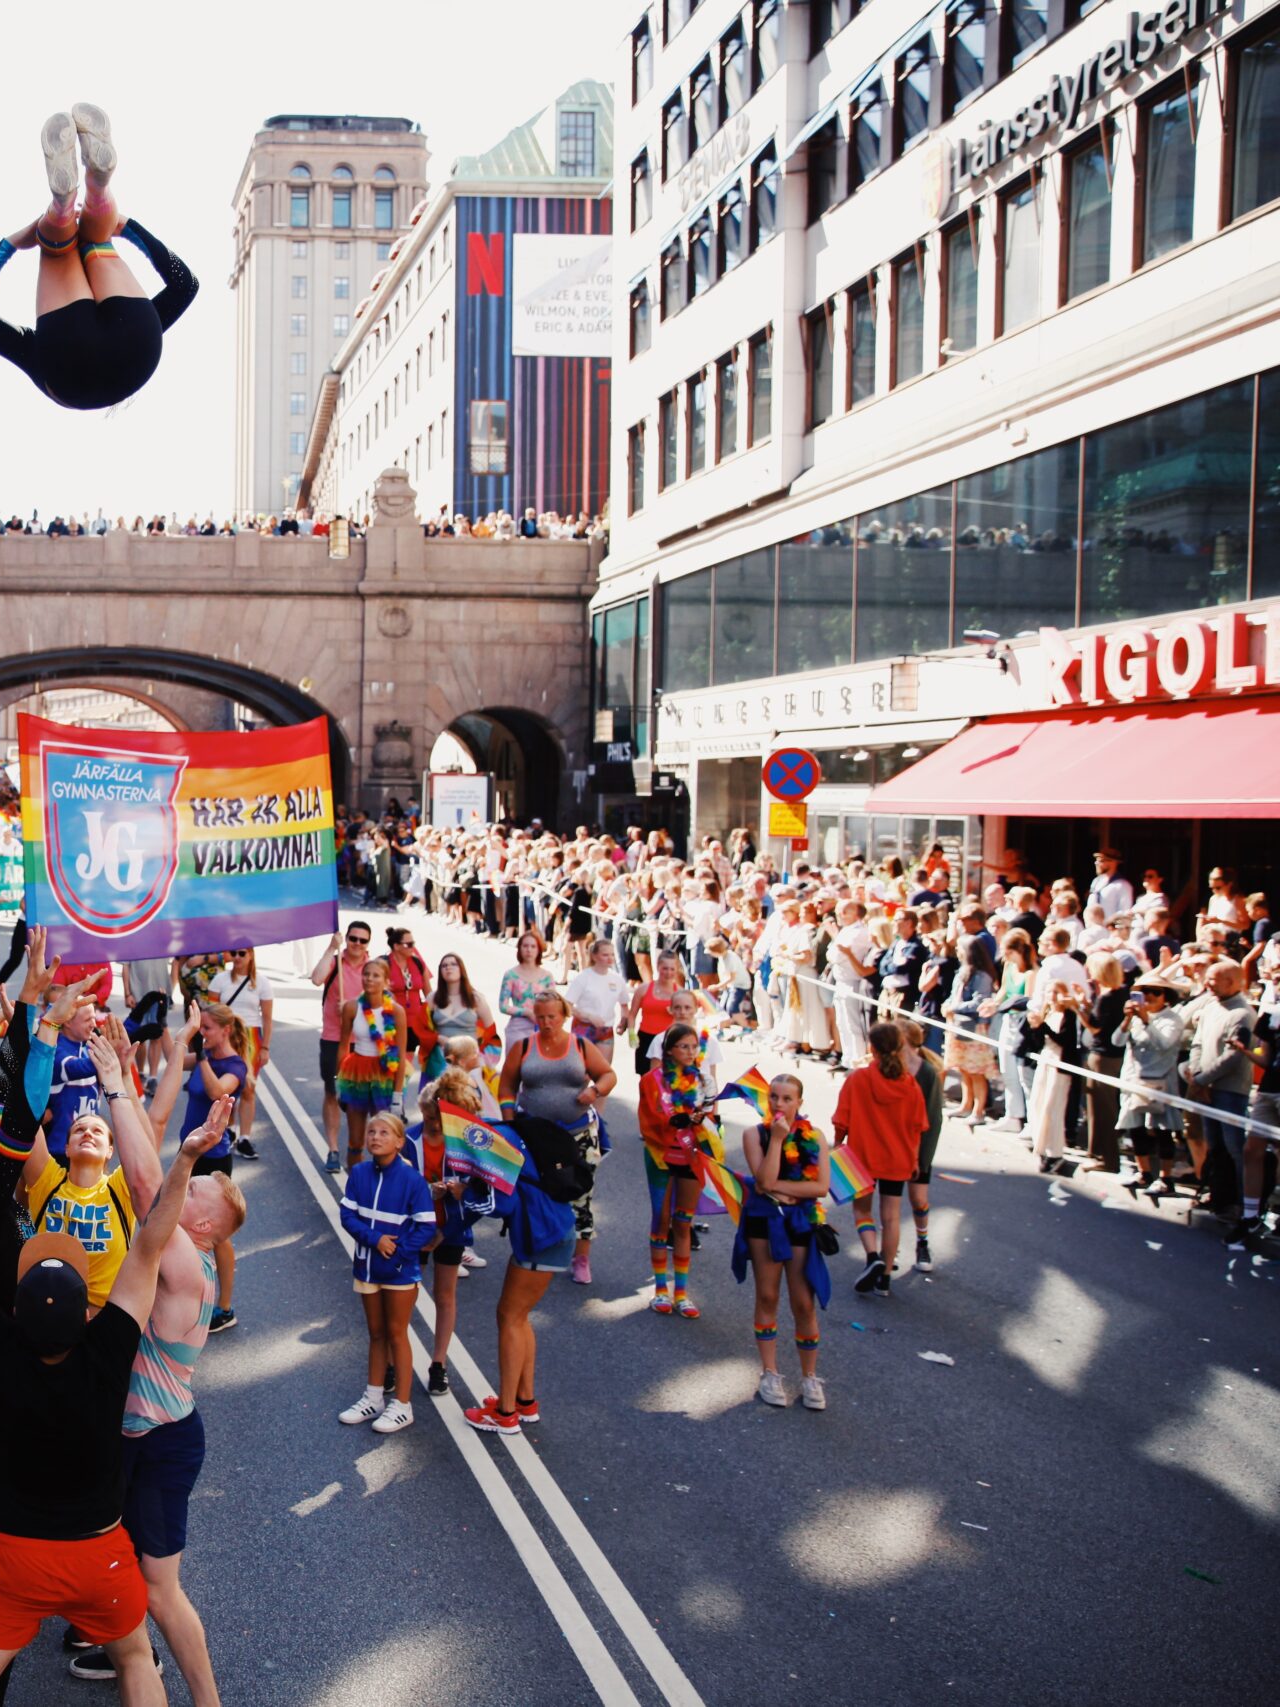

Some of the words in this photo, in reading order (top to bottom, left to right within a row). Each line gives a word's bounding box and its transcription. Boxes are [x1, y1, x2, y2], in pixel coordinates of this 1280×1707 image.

[52, 781, 161, 802] GYMNASTERNA
[72, 760, 143, 783] JÄRFÄLLA
[189, 796, 244, 828] HÄR
[251, 793, 280, 825] ÄR
[286, 785, 323, 822] ALLA
[75, 811, 145, 892] JG
[191, 831, 322, 877] VÄLKOMNA!
